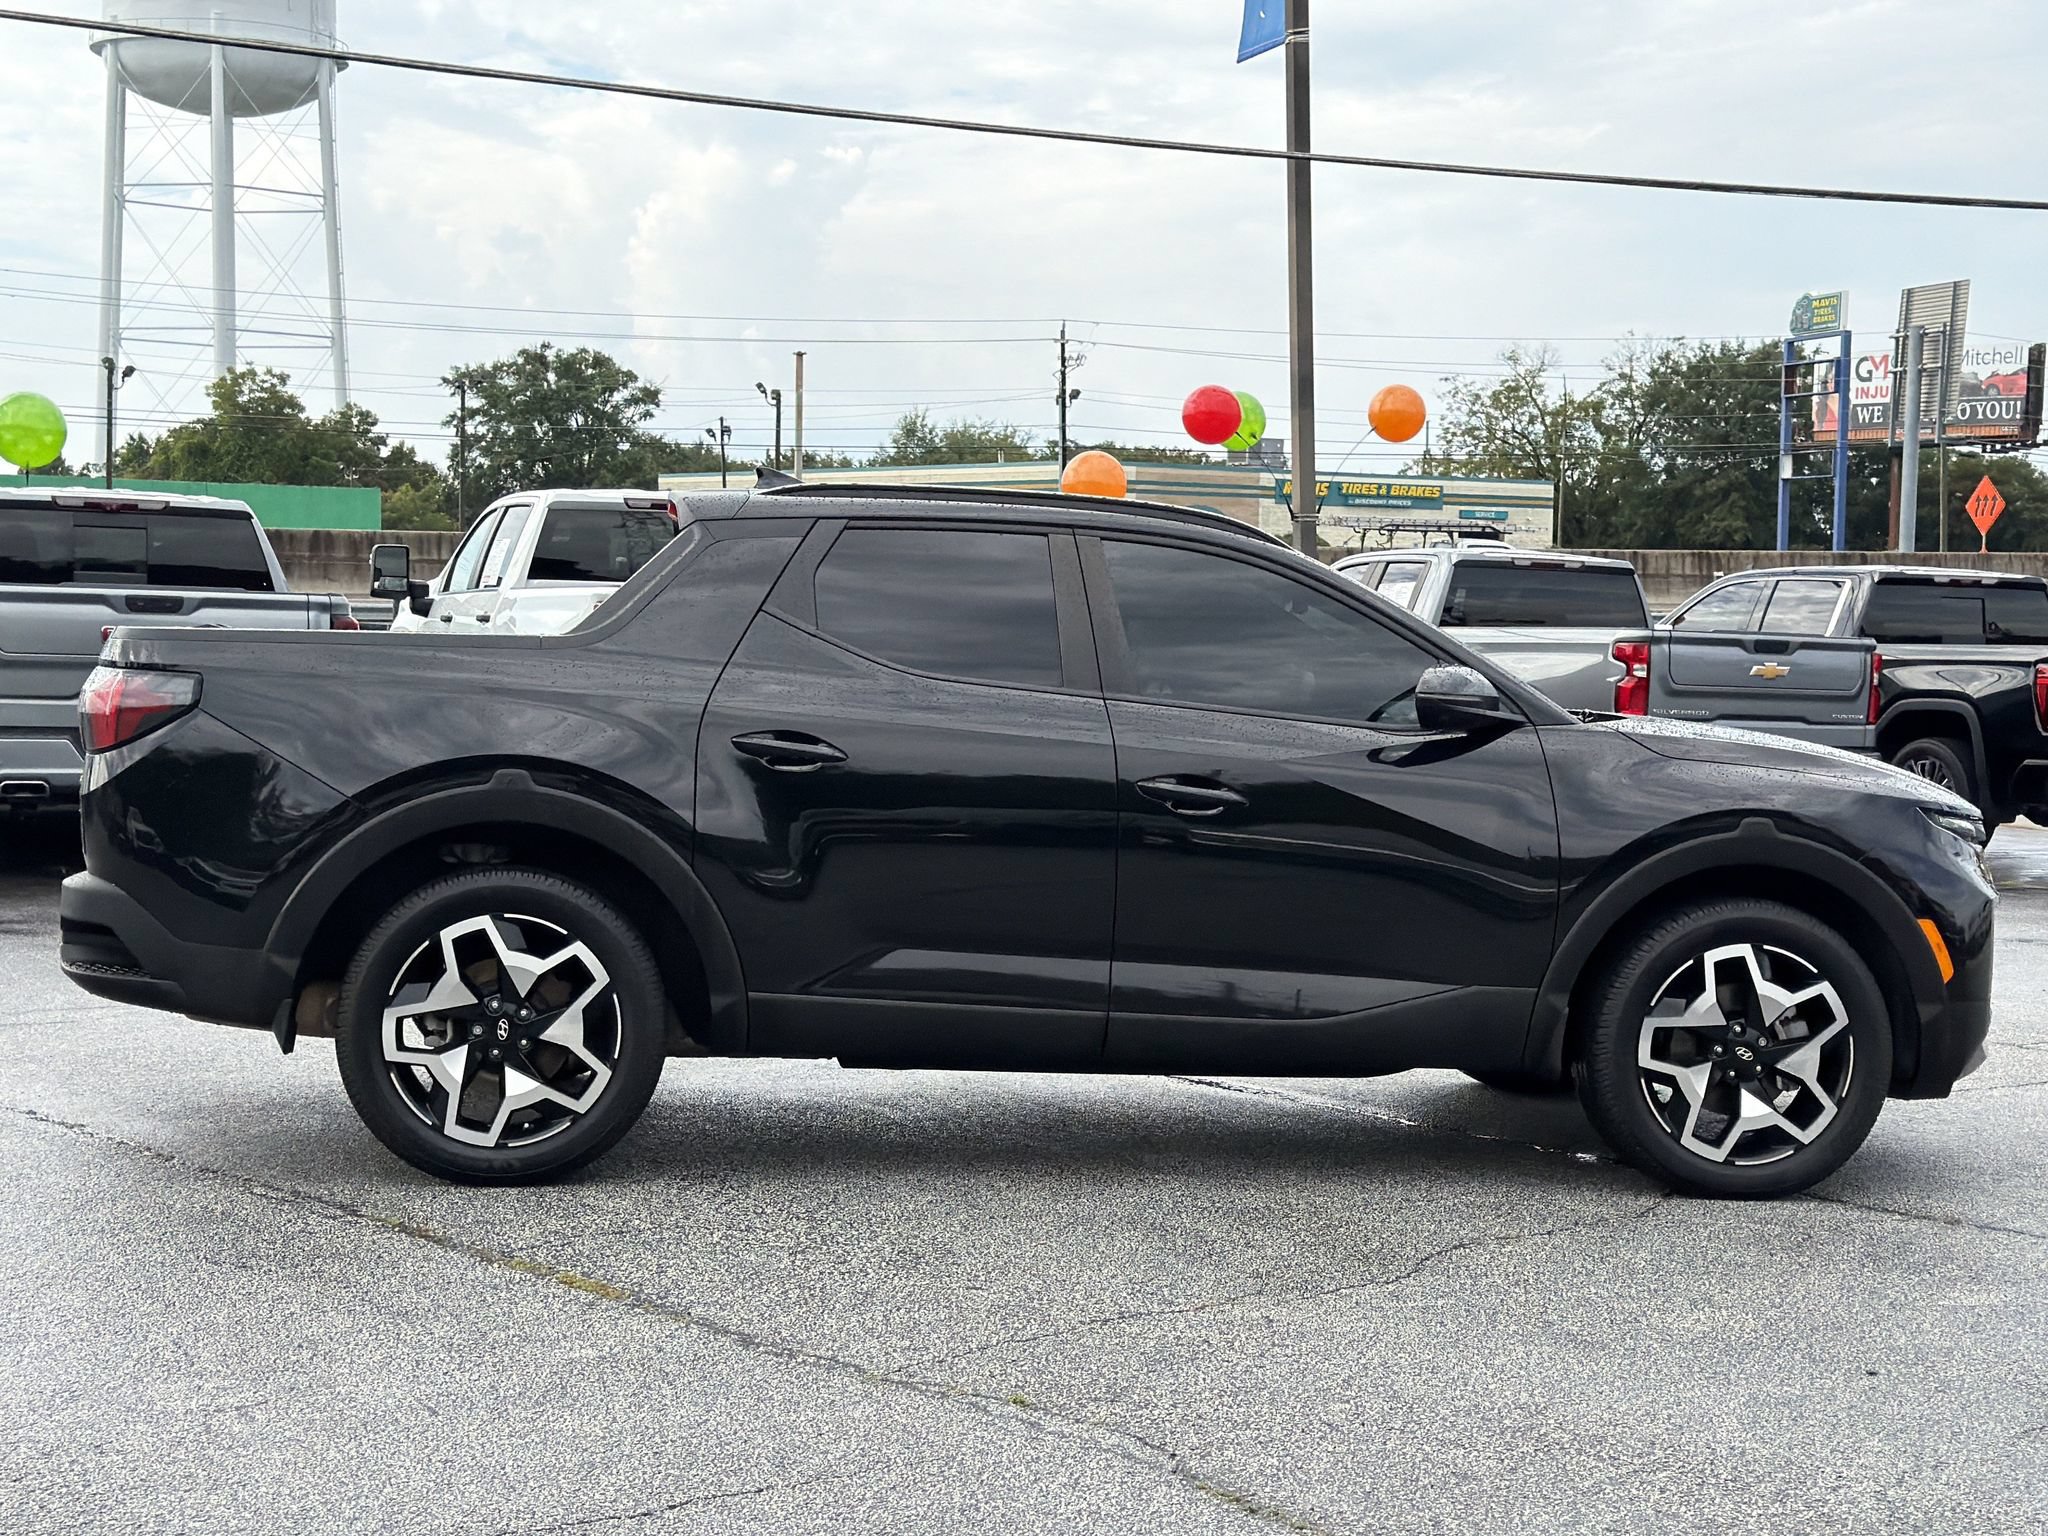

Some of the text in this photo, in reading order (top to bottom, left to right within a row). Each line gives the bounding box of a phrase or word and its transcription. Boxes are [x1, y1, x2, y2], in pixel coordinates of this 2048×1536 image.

[1811, 296, 1838, 308] MAVIS
[1855, 386, 1889, 400] INJU
[1856, 405, 1884, 424] WE
[1976, 401, 2022, 419] YOU!
[1282, 481, 1441, 498] MIS TIRES & BRAKES
